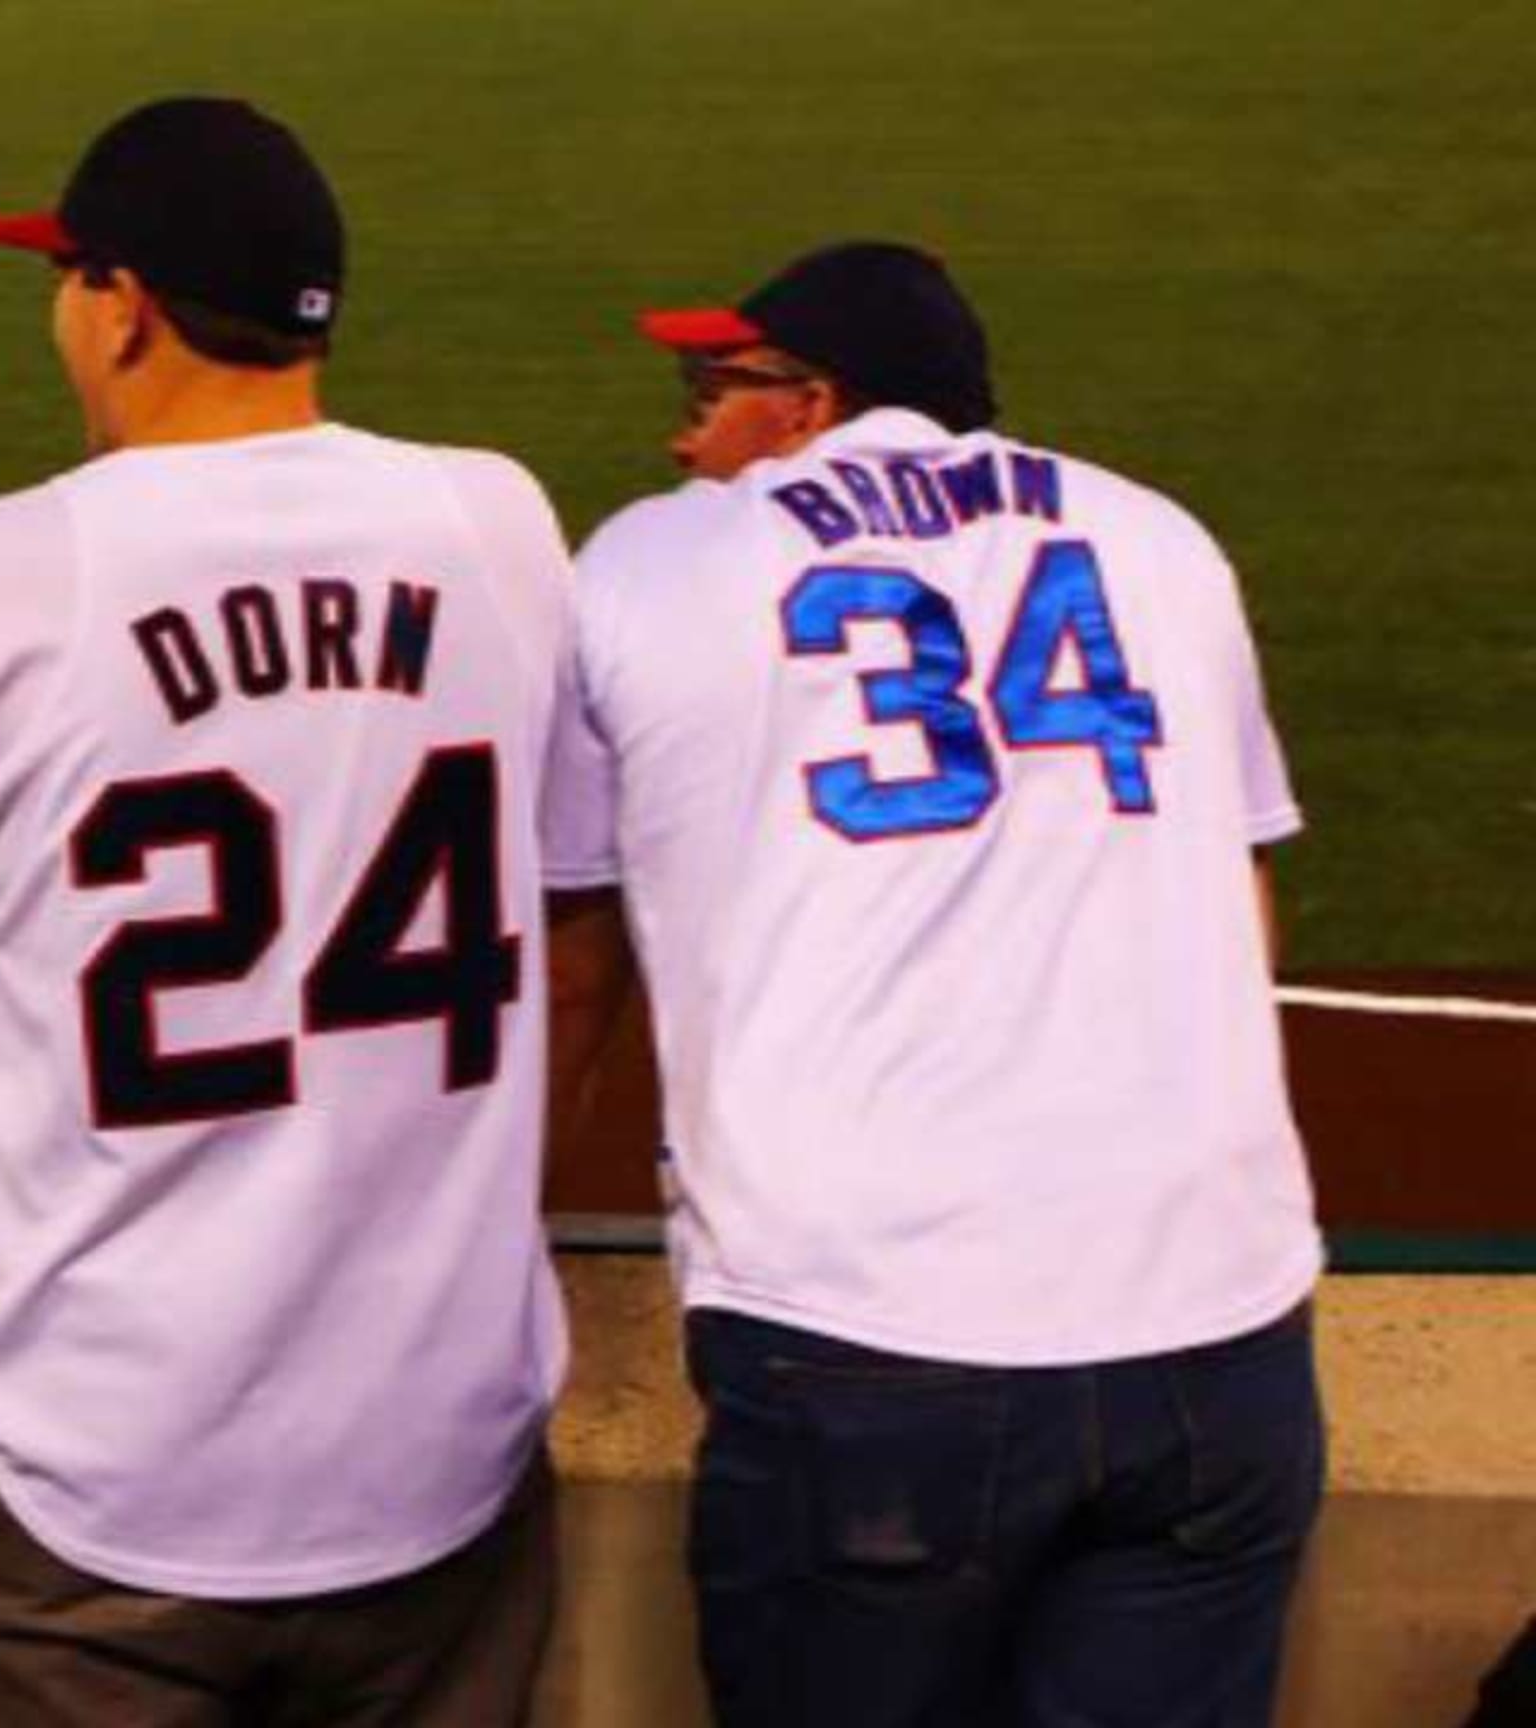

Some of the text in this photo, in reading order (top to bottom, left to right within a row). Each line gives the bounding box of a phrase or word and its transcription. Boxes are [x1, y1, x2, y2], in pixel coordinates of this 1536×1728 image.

[771, 451, 1063, 549] BROWN
[130, 577, 439, 727] DORN
[779, 539, 1163, 843] 34
[69, 742, 522, 1131] 24
